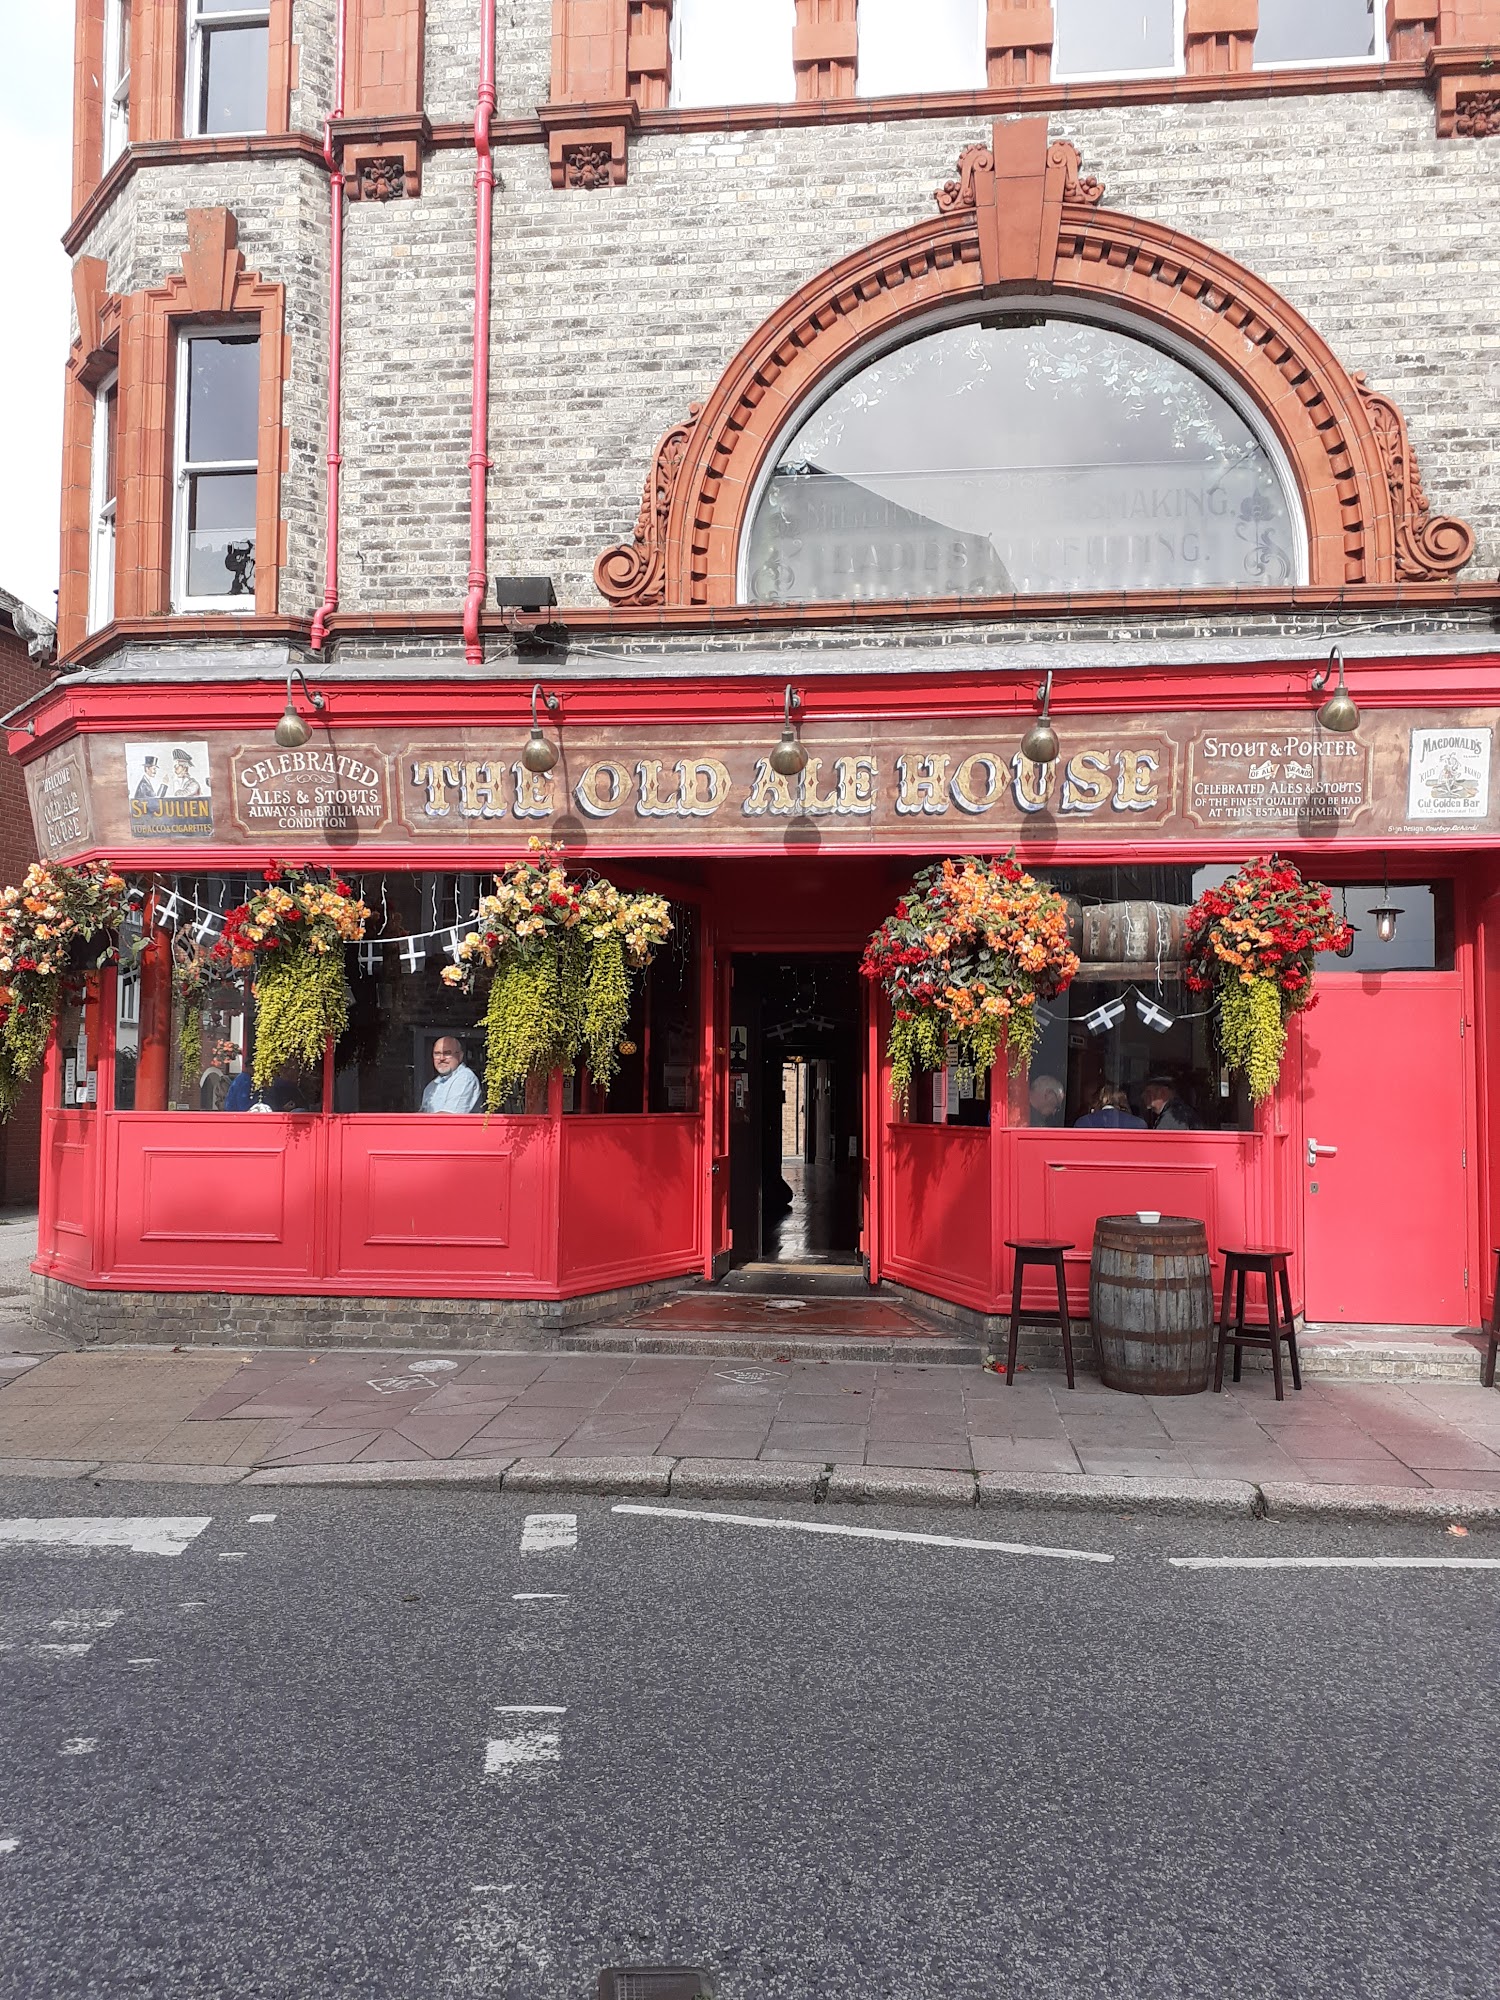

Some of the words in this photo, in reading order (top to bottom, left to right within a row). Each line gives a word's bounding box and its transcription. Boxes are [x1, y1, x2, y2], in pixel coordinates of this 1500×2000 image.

[1204, 737, 1268, 757] STOUT
[1270, 742, 1282, 756] &
[1283, 736, 1358, 757] PORTER
[241, 751, 379, 788] CELEBRATED
[1261, 766, 1275, 776] ALL
[1286, 766, 1312, 777] BRANDS
[42, 768, 71, 793] WELCOME
[412, 758, 555, 818] THE
[573, 756, 733, 818] OLD
[743, 755, 879, 817] ALE
[895, 748, 1161, 816] HOUSE
[1194, 783, 1265, 795] CELEBRATED
[1269, 782, 1303, 794] ALES
[1315, 782, 1362, 794] STOUTS
[246, 788, 291, 805] ALES
[296, 789, 310, 805] &
[314, 786, 379, 804] STOUTS
[1194, 798, 1207, 807] OF
[1208, 797, 1229, 807] THE
[1230, 797, 1264, 806] FINEST
[1265, 797, 1310, 807] QUALITY
[1312, 797, 1326, 805] TO
[1327, 796, 1339, 805] BE
[1340, 796, 1362, 805] HAD
[153, 799, 209, 818] JULIEN
[1433, 798, 1461, 808] Golden
[1463, 798, 1480, 808] Bar
[248, 805, 297, 818] ALWAYS
[299, 806, 312, 817] in
[316, 805, 382, 817] BRILLIANT
[1208, 808, 1222, 818] AT
[1225, 808, 1252, 818] THIS
[1255, 807, 1350, 818] ESTABLISHMENT
[278, 817, 347, 828] CONDITION
[1403, 825, 1424, 834] Design
